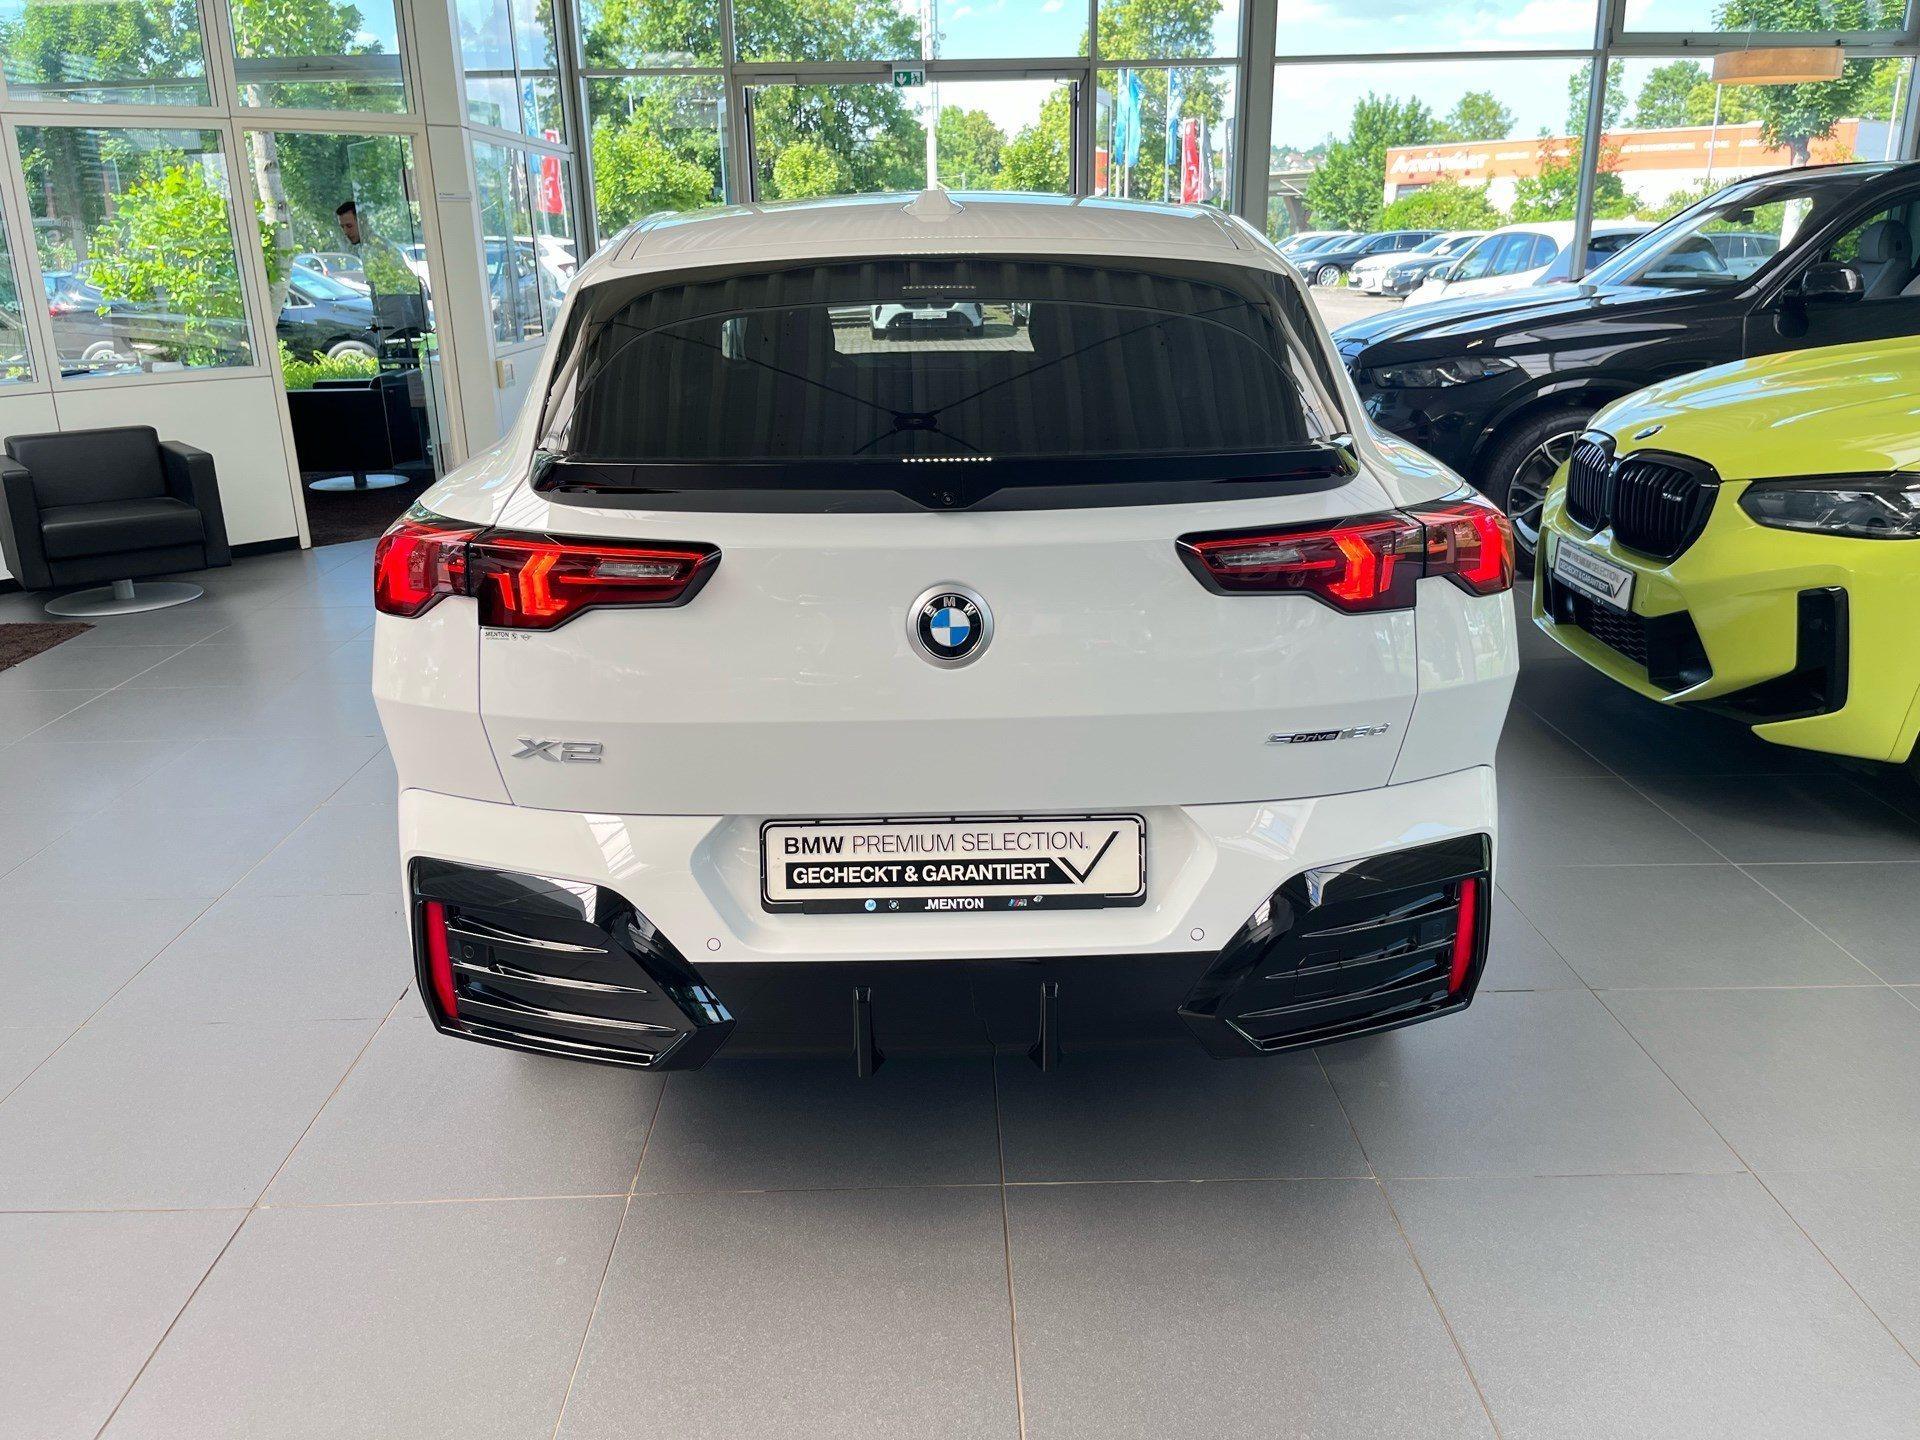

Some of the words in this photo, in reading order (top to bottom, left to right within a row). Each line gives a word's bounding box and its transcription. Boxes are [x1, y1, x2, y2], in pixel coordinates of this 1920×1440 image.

[924, 596, 976, 617] BMW
[511, 737, 604, 762] X2
[784, 835, 844, 855] BMW
[852, 834, 955, 853] PREMIUM
[793, 866, 901, 884] GECHECKT
[904, 866, 918, 882] &
[922, 862, 1050, 882] GARANTIERT
[924, 898, 984, 910] MENTON
